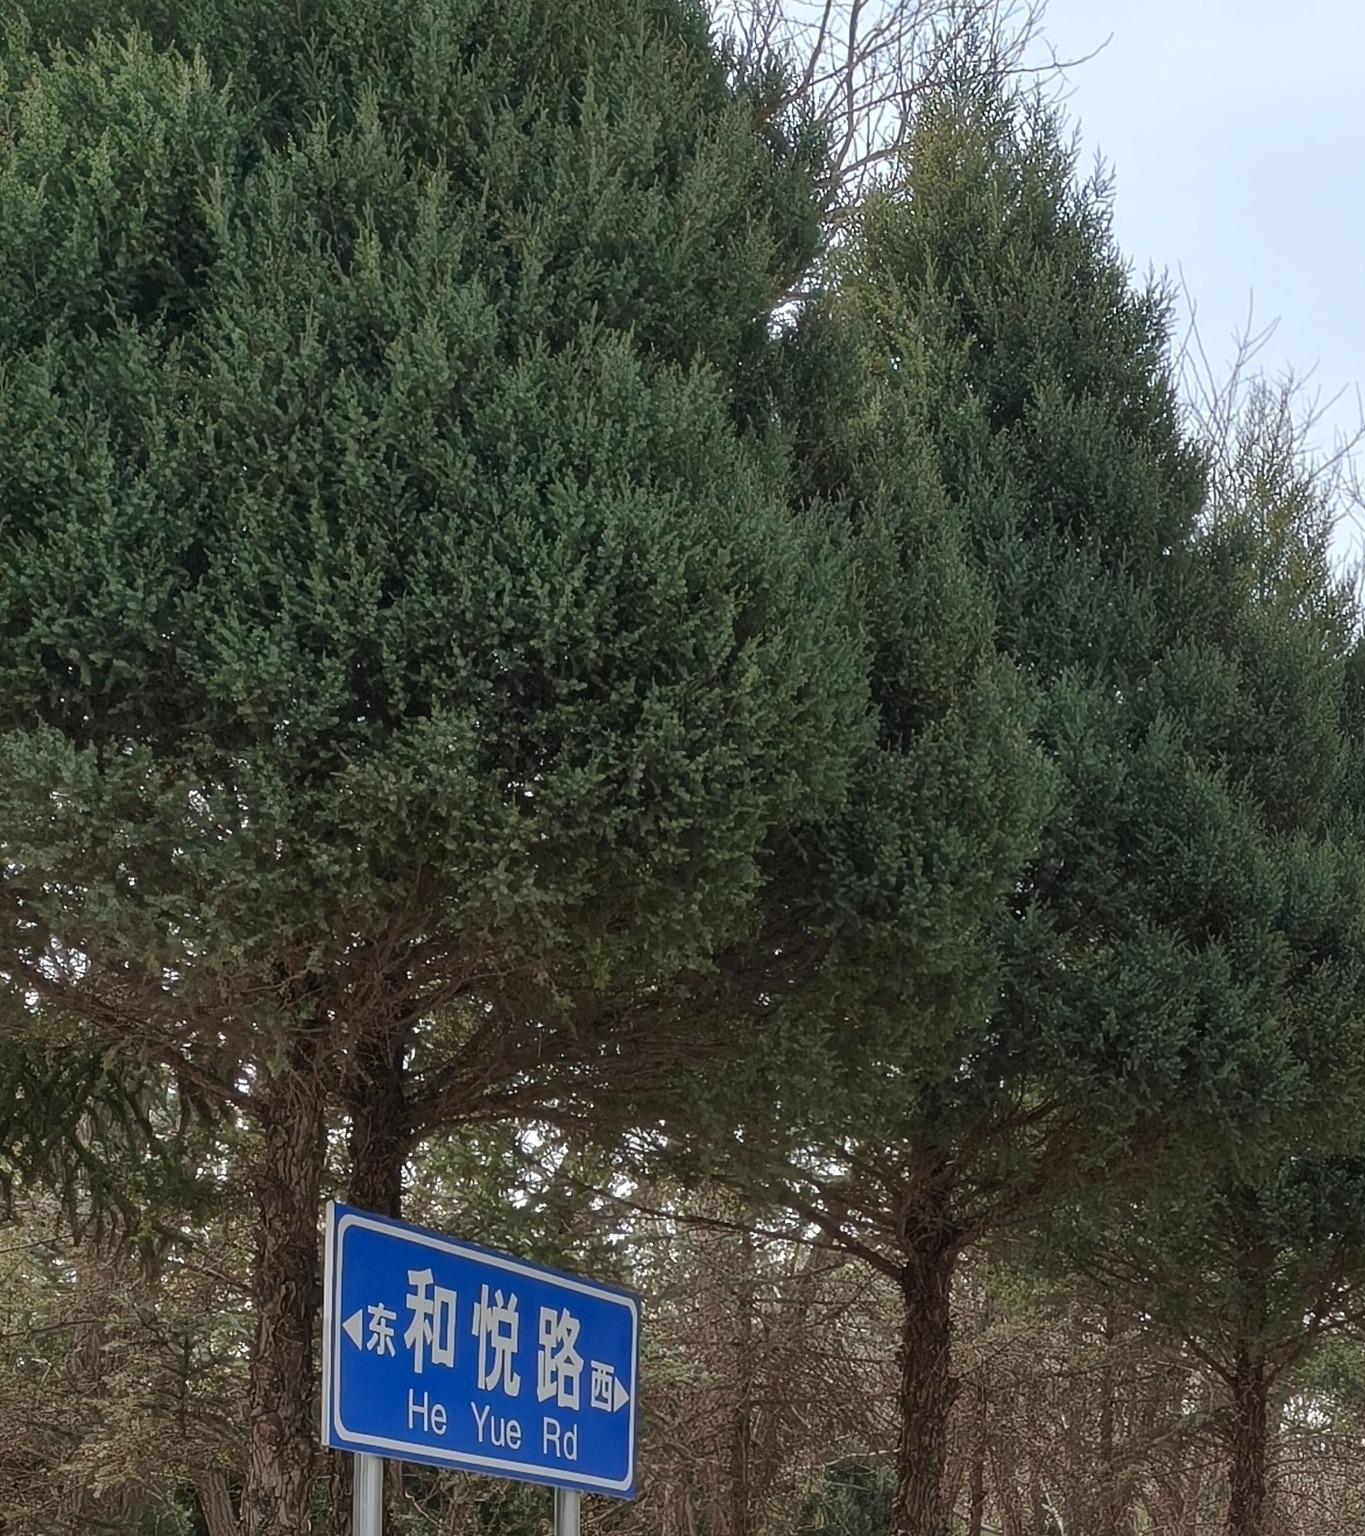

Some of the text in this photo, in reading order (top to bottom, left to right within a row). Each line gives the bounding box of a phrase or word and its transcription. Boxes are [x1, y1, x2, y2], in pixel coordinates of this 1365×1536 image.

[367, 1268, 615, 1412] 东 和悦路 西
[408, 1388, 578, 1461] He Yue Rd
